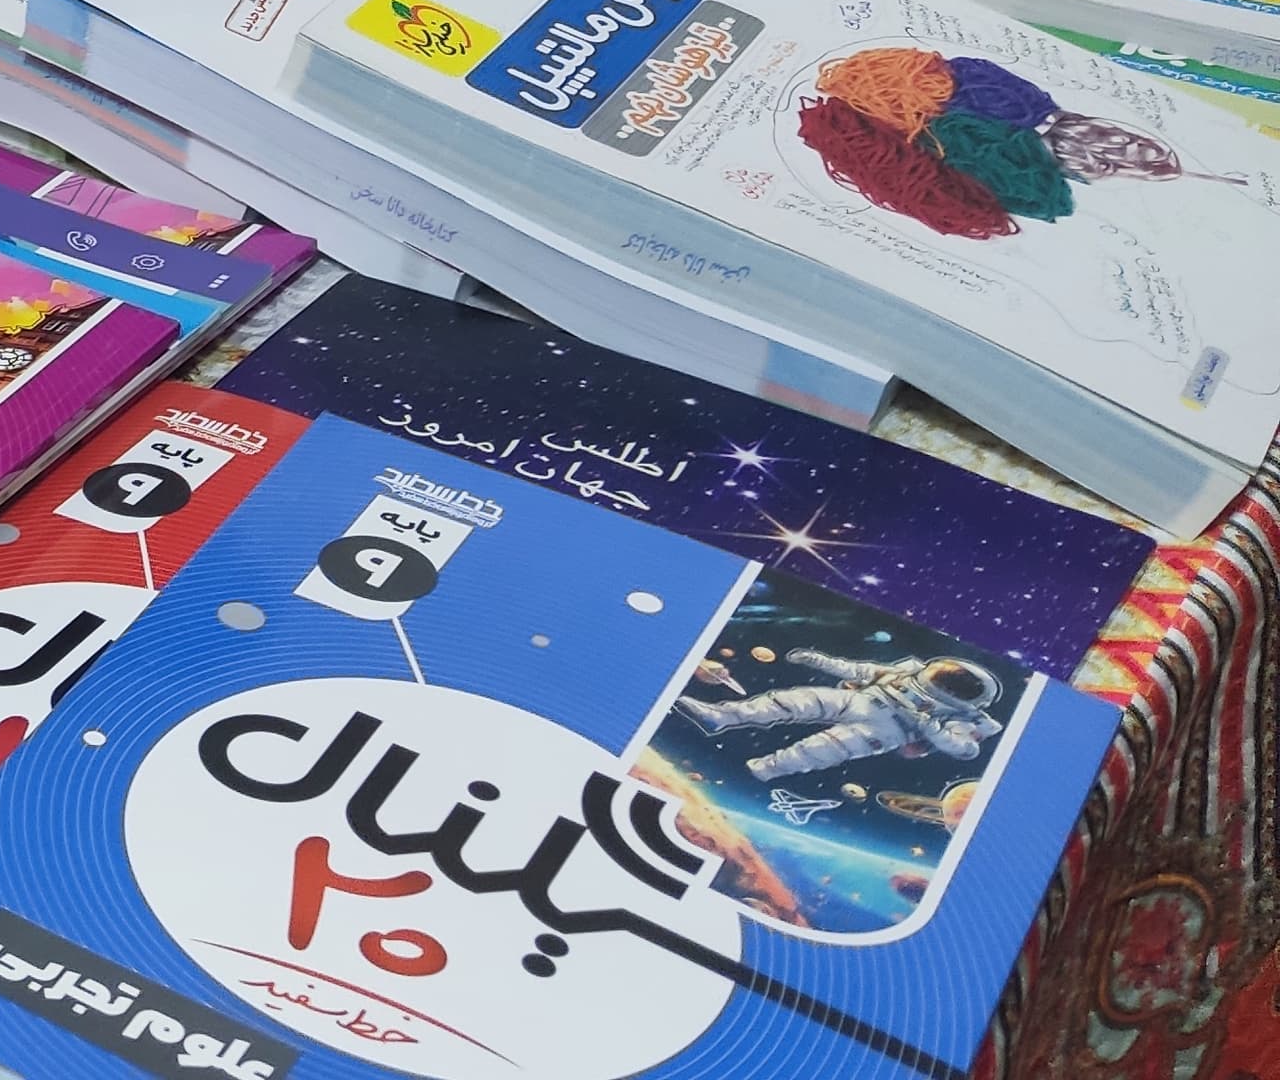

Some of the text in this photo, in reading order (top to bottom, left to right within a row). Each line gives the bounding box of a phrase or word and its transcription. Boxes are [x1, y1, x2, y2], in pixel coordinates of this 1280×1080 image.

[239, 10, 262, 33] جدید
[644, 16, 736, 100] تیزهوشان
[504, 5, 622, 113] مالتیپل
[150, 438, 204, 466] پایه
[379, 406, 653, 514] جهان امروز
[540, 422, 692, 483] اطلس
[120, 472, 163, 506] ۹
[377, 507, 443, 543] پایه
[353, 548, 406, 590] ۹
[199, 710, 830, 1012] سیگنال
[288, 835, 449, 977] ۲۰
[119, 1002, 278, 1080] علوم
[238, 975, 420, 1048] خط سفید
